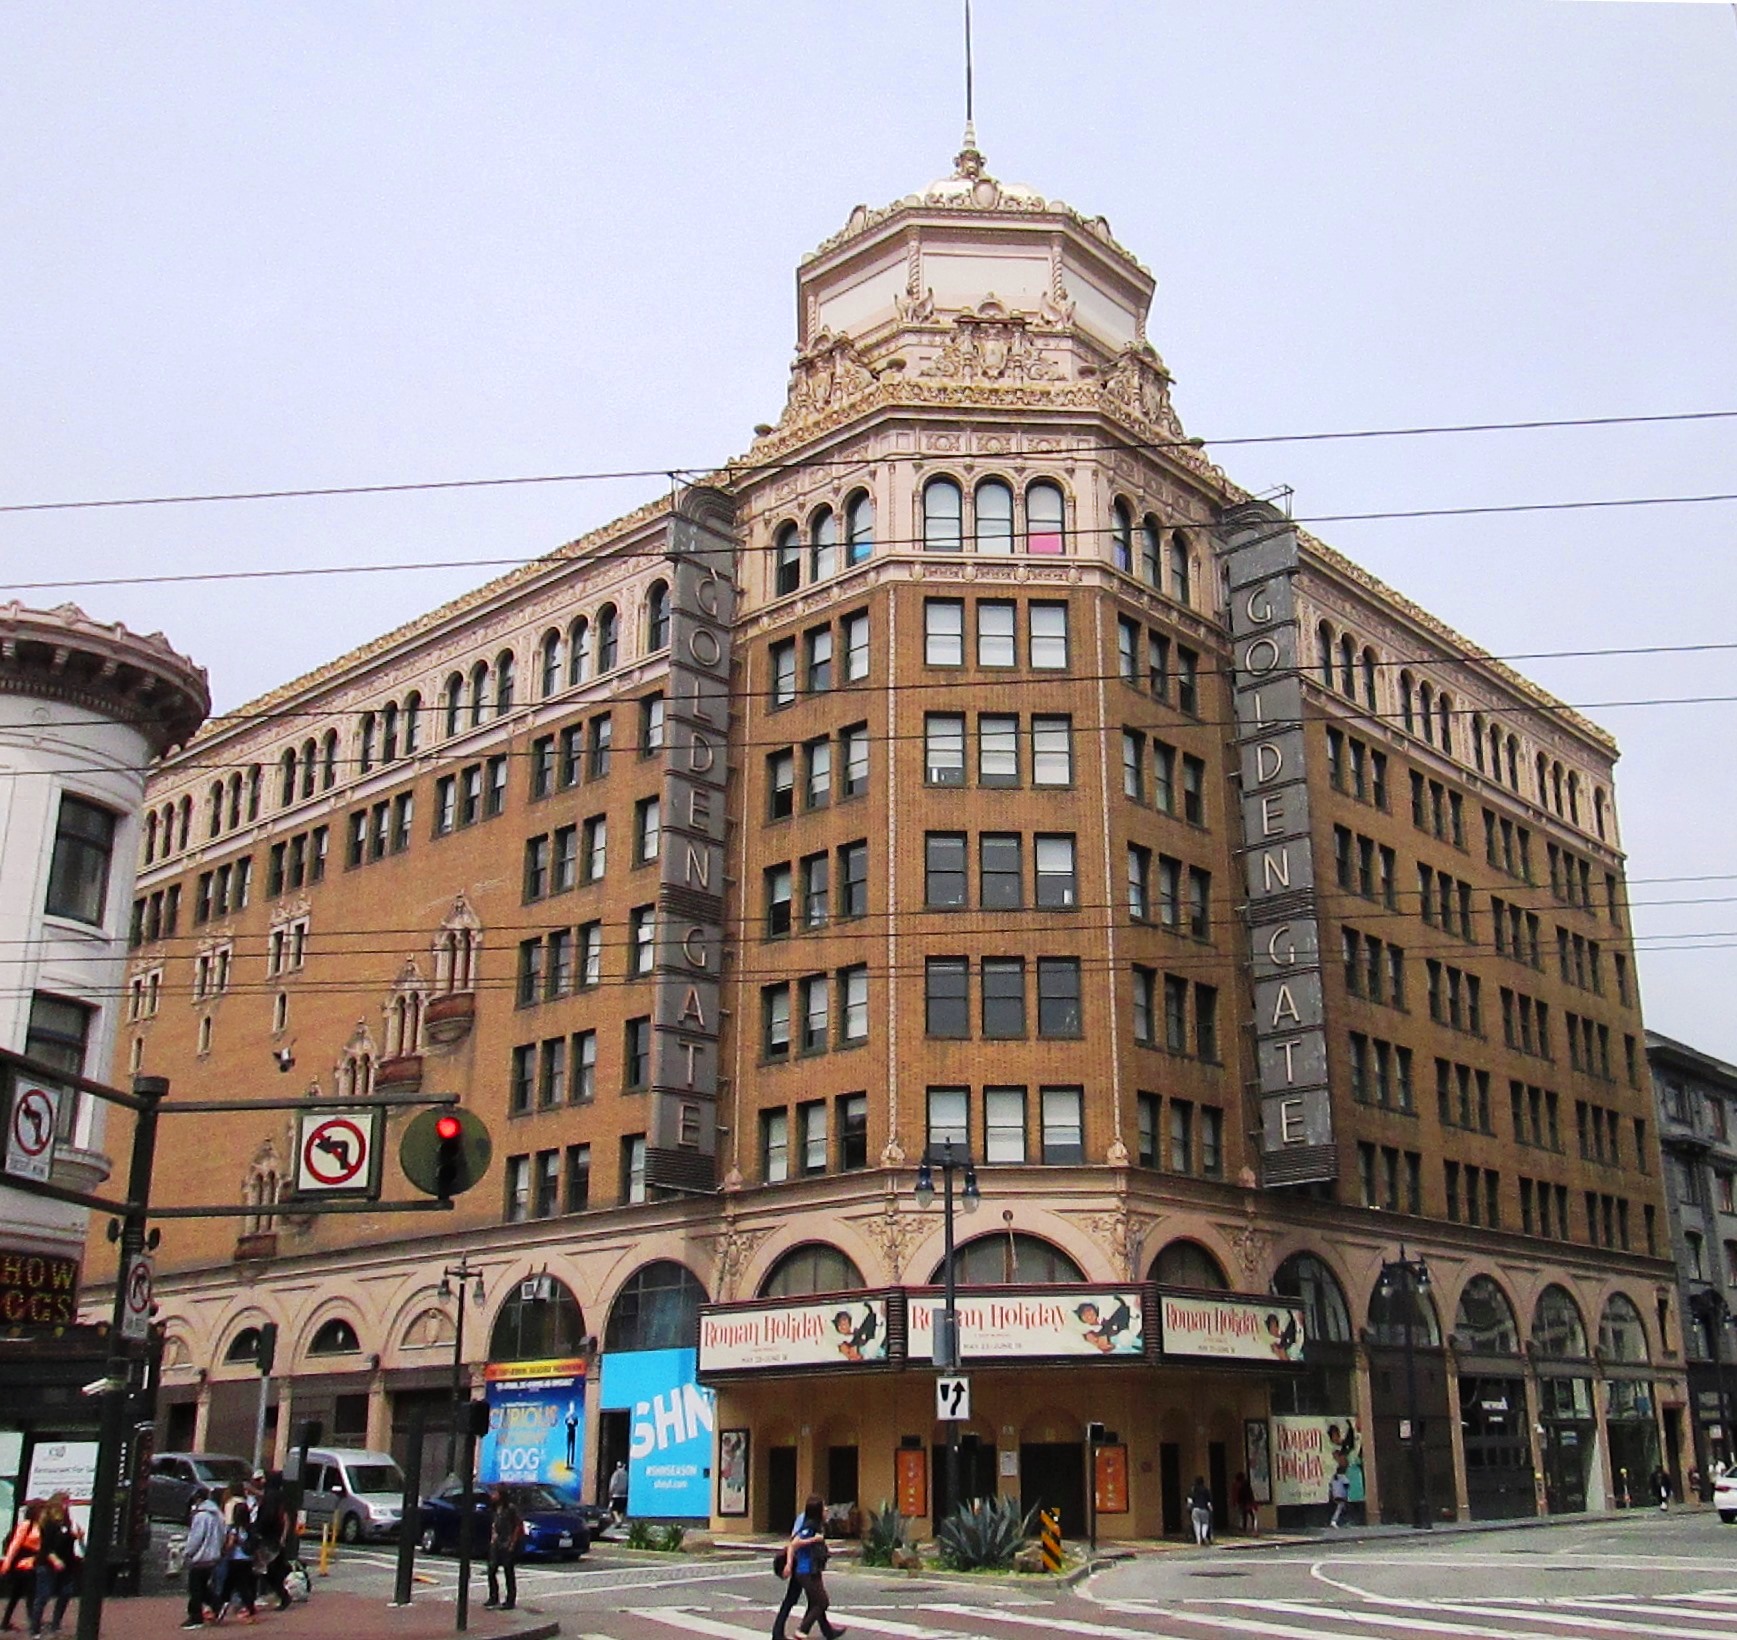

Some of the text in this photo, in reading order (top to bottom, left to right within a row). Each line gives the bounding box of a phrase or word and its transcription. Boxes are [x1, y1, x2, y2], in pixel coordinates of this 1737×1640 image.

[677, 566, 722, 1147] GOLDEN GATE
[1245, 586, 1305, 1144] GOLDEN GATE
[704, 1312, 826, 1348] Roman Holiday
[988, 1302, 1066, 1333] Holiday
[1165, 1302, 1261, 1342] Roman Holiday
[630, 1383, 714, 1460] SHN
[1276, 1423, 1323, 1454] Roman
[500, 1447, 541, 1472] DOG
[1275, 1451, 1324, 1487] Holiday
